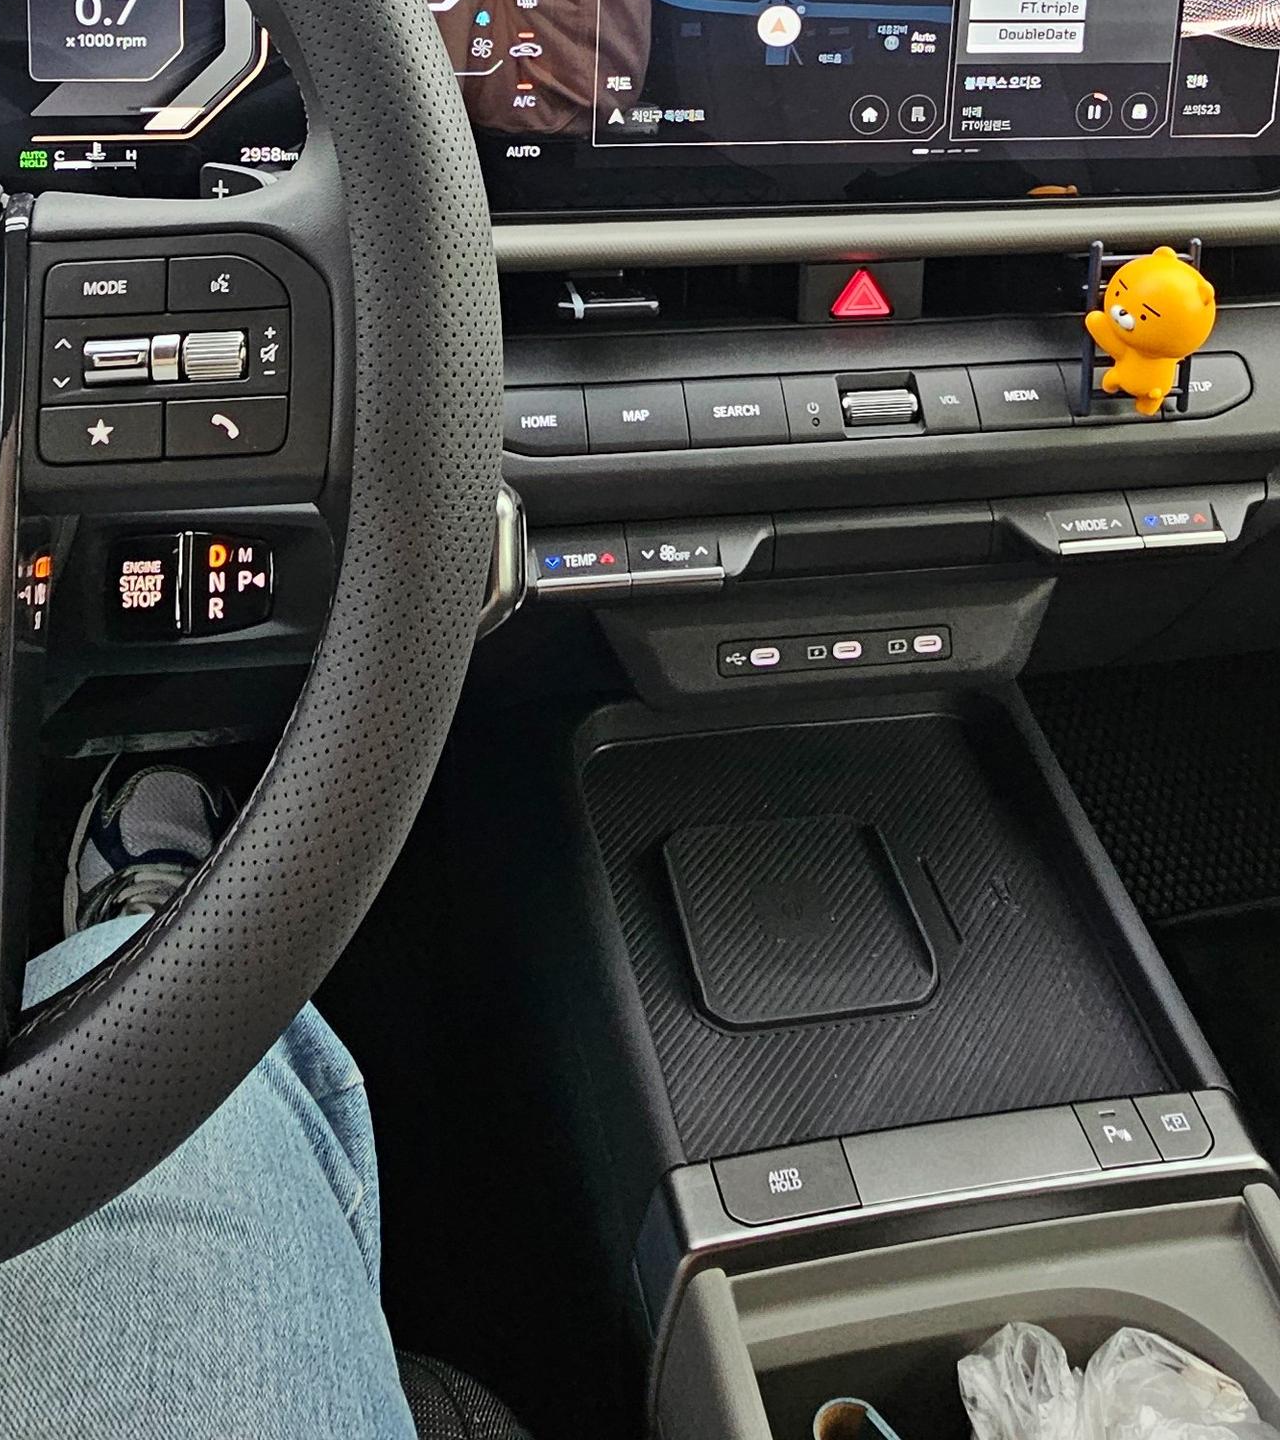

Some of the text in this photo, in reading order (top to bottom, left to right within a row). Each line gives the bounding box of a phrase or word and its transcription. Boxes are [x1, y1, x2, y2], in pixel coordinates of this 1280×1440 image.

[1020, 1, 1080, 16] FT.triple
[910, 31, 937, 42] Auto
[998, 28, 1077, 40] DoubleDate
[116, 35, 147, 51] rpm
[606, 76, 632, 92] 지도
[964, 76, 1042, 90] 블루투스 오디오
[1186, 74, 1209, 88] 전화
[513, 95, 537, 109] A/C
[631, 110, 663, 123] 처인구
[19, 150, 47, 160] AUTO
[53, 150, 138, 161] C H
[506, 145, 541, 158] AUTO
[19, 160, 47, 169] HOLD
[83, 279, 128, 297] MODE
[1188, 381, 1213, 393] ETUP
[939, 394, 960, 406] VOL
[1004, 389, 1039, 403] MEDIA
[622, 409, 650, 423] MAP
[712, 404, 761, 419] SEARCH
[521, 415, 558, 428] HOME
[1075, 517, 1109, 533] MODE
[1160, 512, 1190, 527] TEMP
[122, 560, 162, 574] ENGINE
[563, 553, 598, 568] TEMP
[119, 574, 165, 593] START
[208, 571, 252, 593] N P
[121, 591, 162, 609] STOP
[208, 597, 224, 620] R
[768, 1168, 799, 1184] AUTO
[769, 1176, 803, 1194] HOLD
